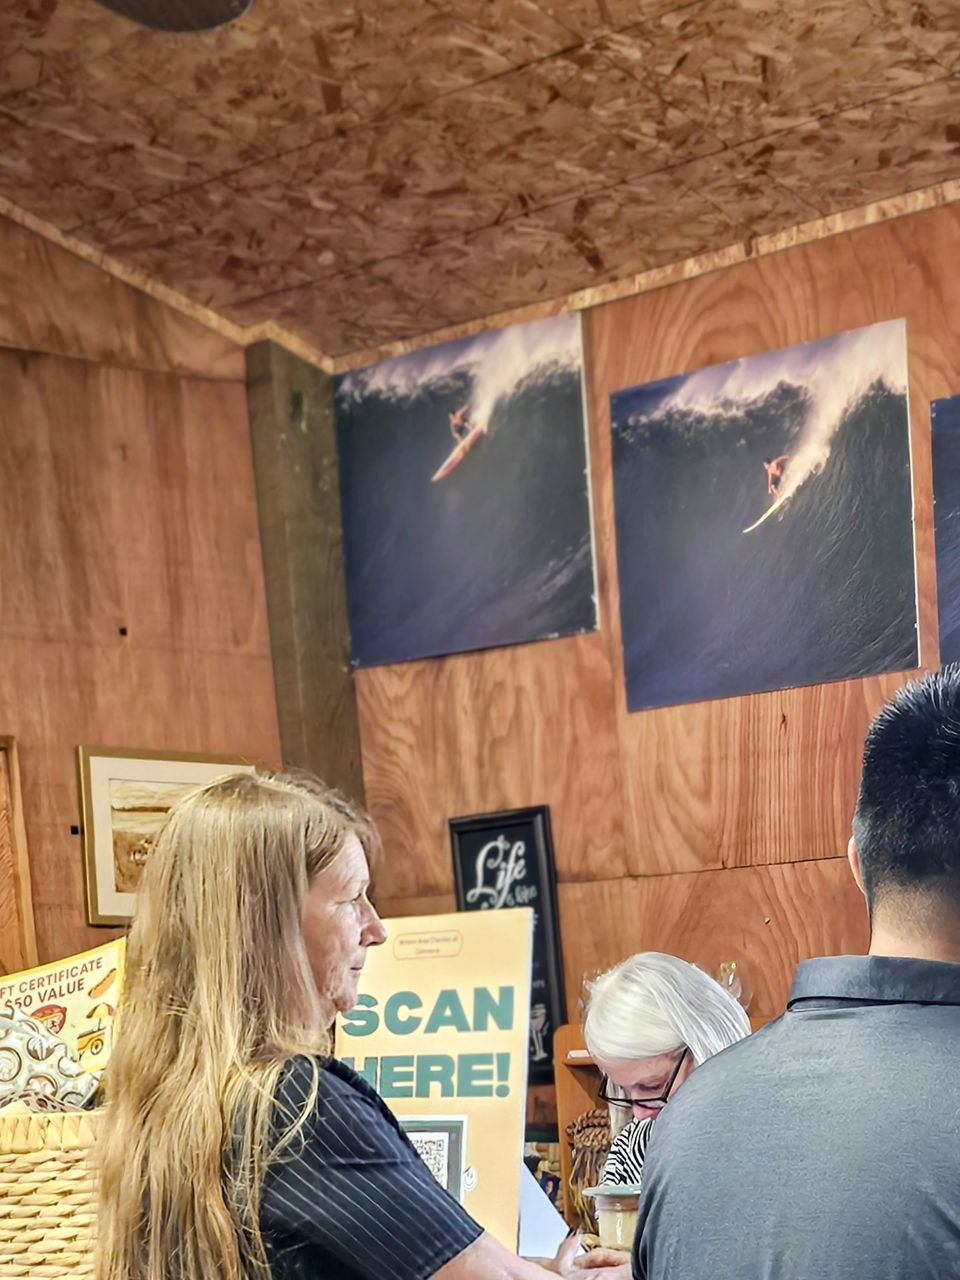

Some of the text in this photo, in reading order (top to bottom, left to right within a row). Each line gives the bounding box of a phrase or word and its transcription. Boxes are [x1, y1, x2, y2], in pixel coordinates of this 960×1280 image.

[19, 957, 103, 994] CERTIFICATE
[38, 978, 85, 1003] VALUE
[341, 986, 515, 1037] SCAN
[341, 1052, 511, 1098] HERE!
